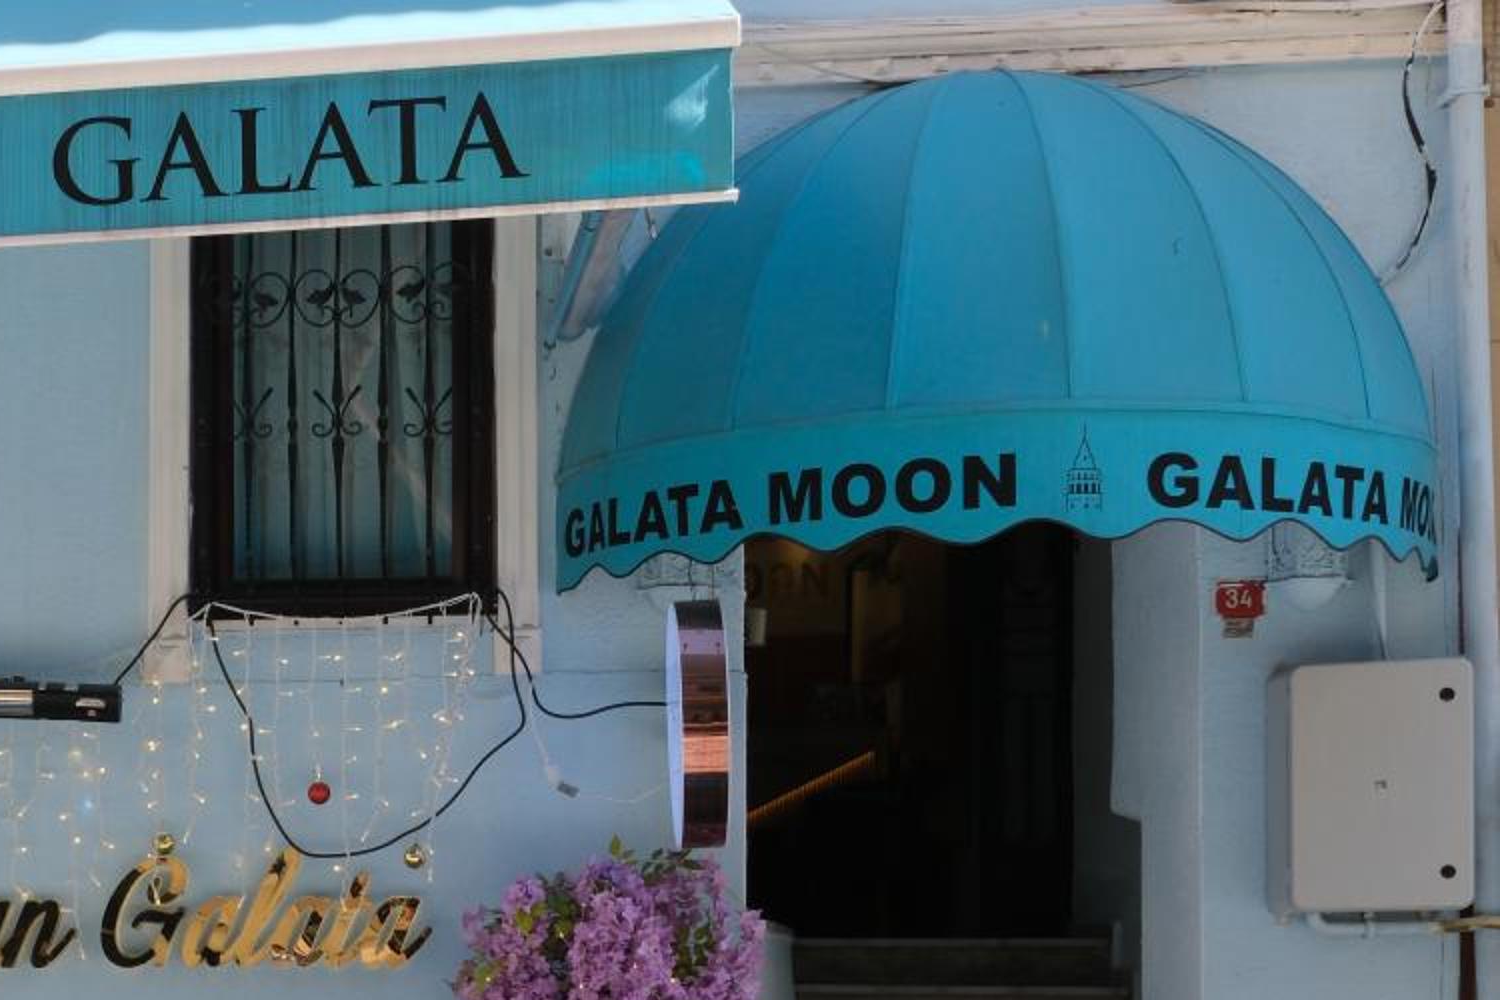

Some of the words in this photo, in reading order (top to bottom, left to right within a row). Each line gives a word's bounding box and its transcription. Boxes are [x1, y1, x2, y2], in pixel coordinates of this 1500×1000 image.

[51, 92, 531, 206] GALATA
[563, 478, 745, 559] GALATA
[767, 453, 1018, 525] MOON
[1146, 451, 1389, 526] GALATA
[1224, 588, 1253, 609] 34
[100, 848, 434, 969] Galata
